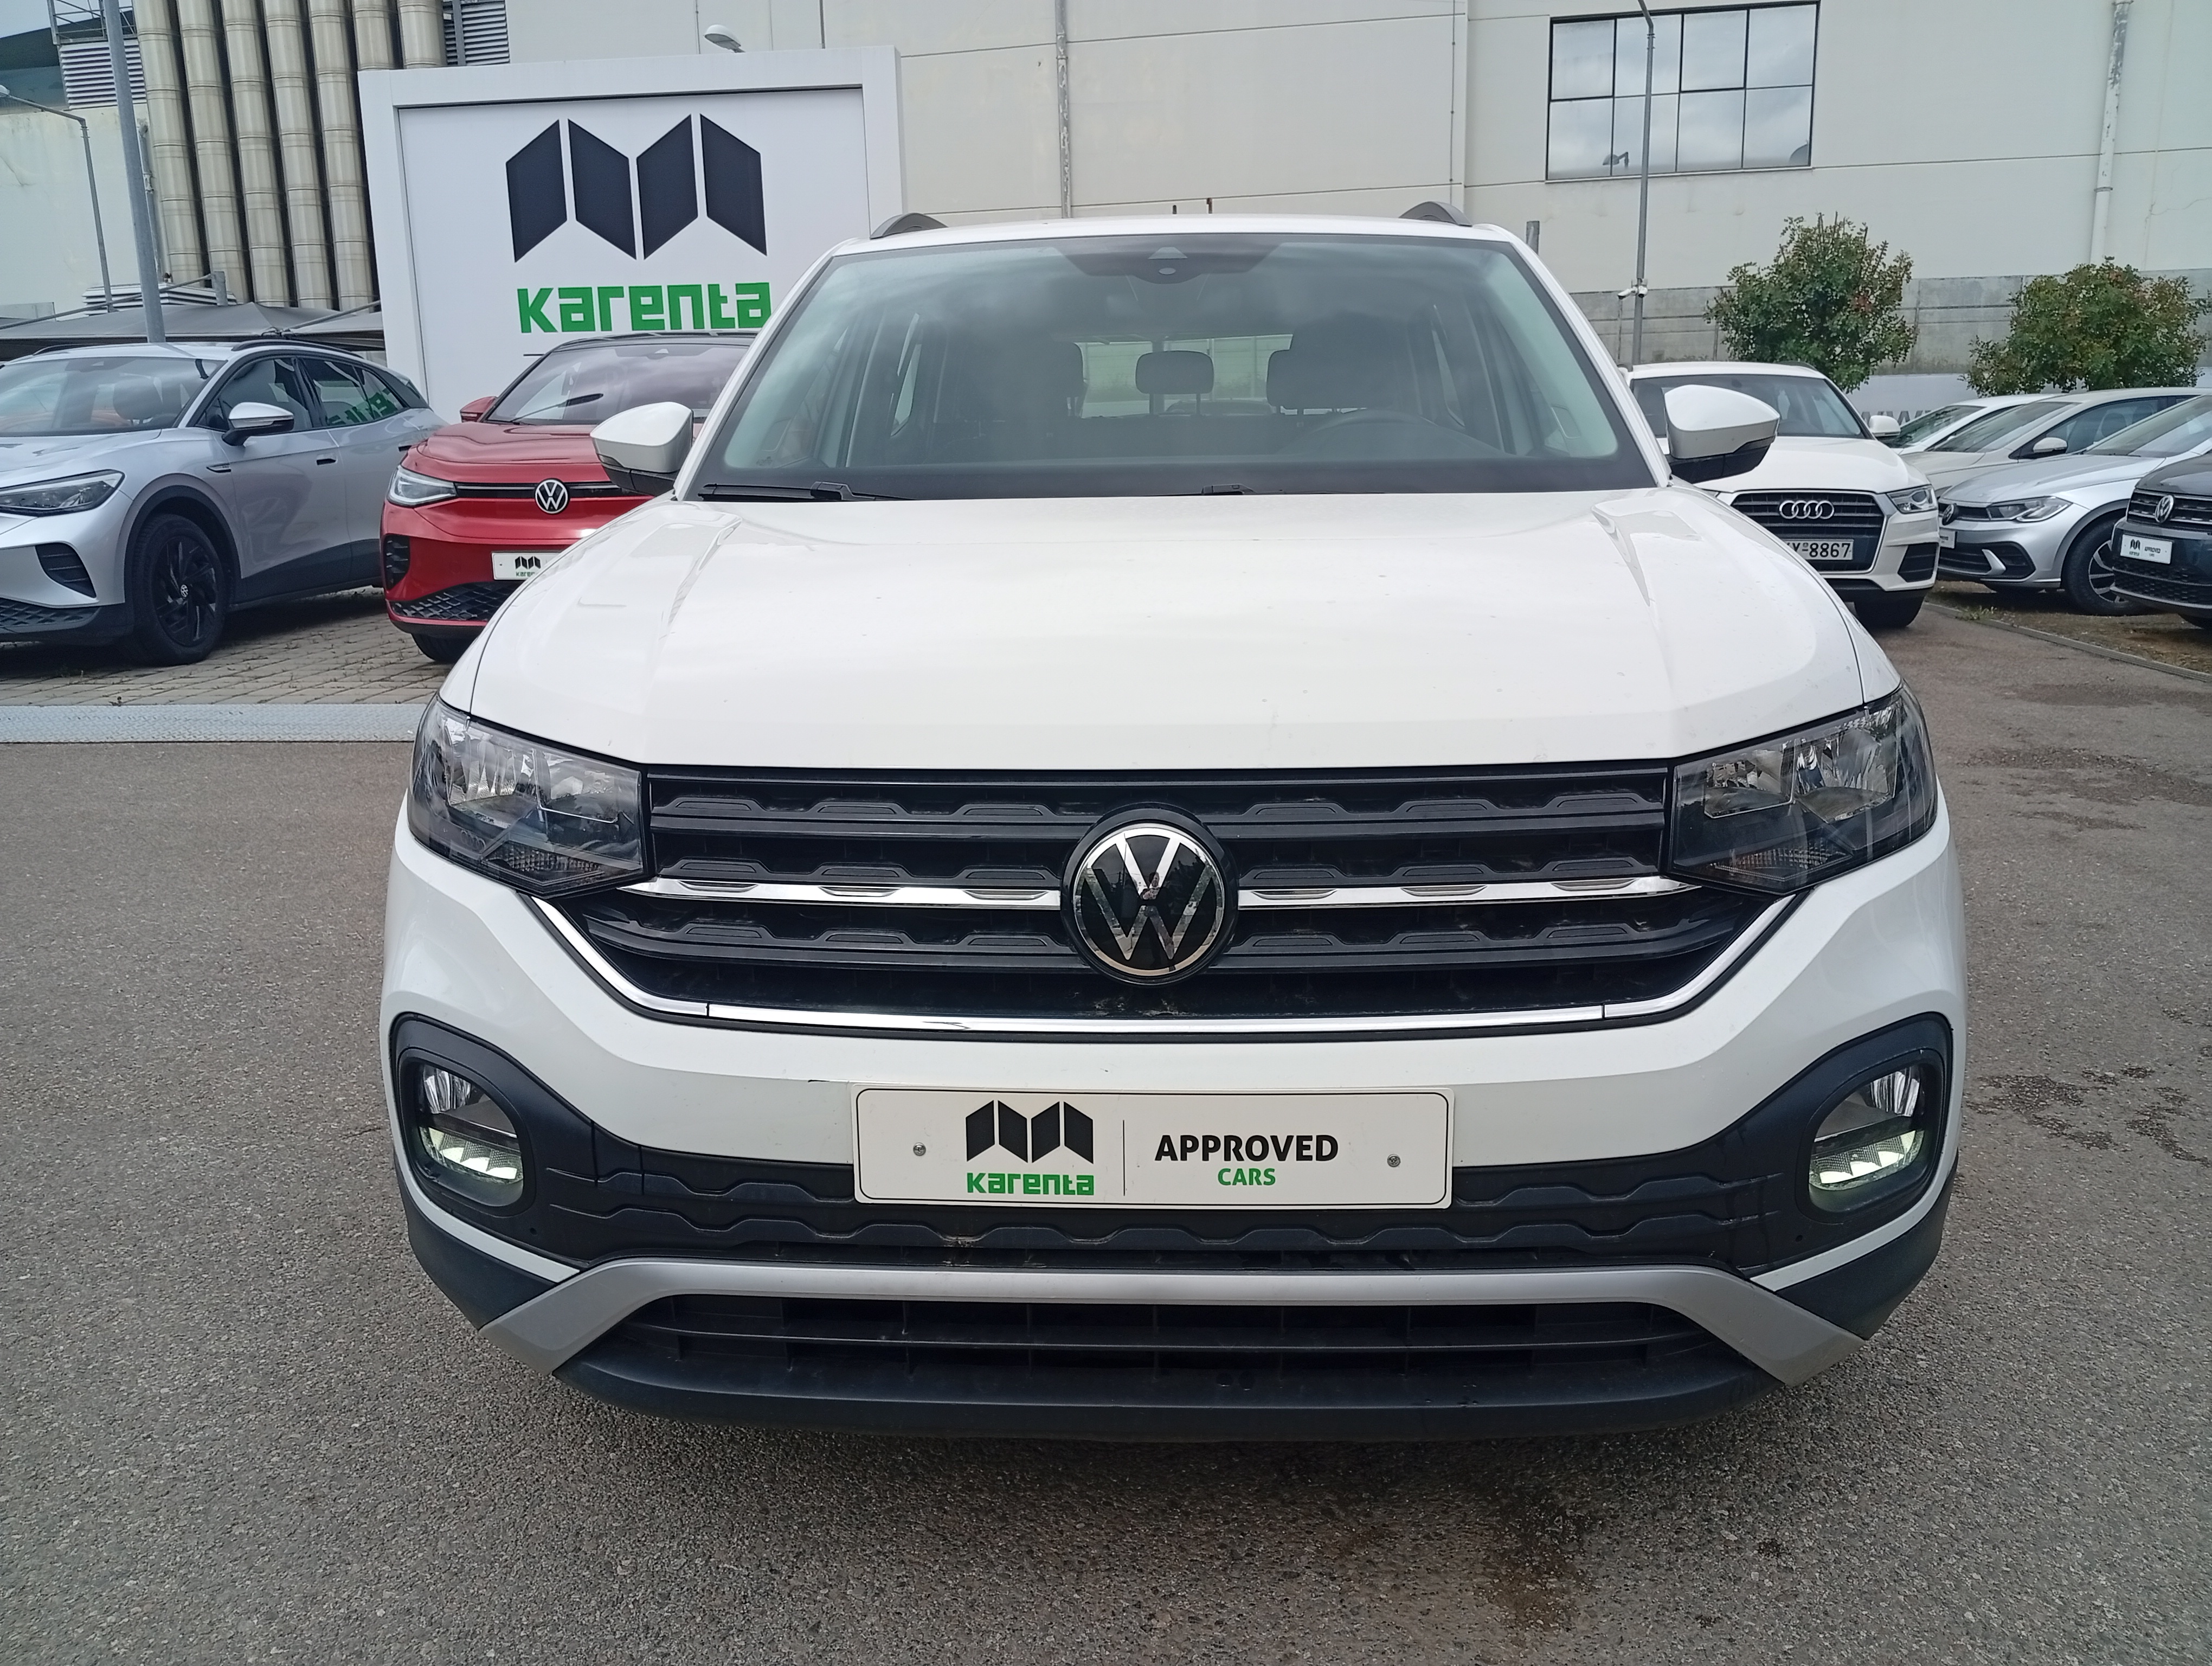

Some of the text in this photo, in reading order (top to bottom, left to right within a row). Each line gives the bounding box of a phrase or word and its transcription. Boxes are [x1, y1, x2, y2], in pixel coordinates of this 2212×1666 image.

[1787, 542, 1851, 558] Y-8867
[1154, 1135, 1339, 1162] APPROVED
[1218, 1168, 1276, 1186] CARS
